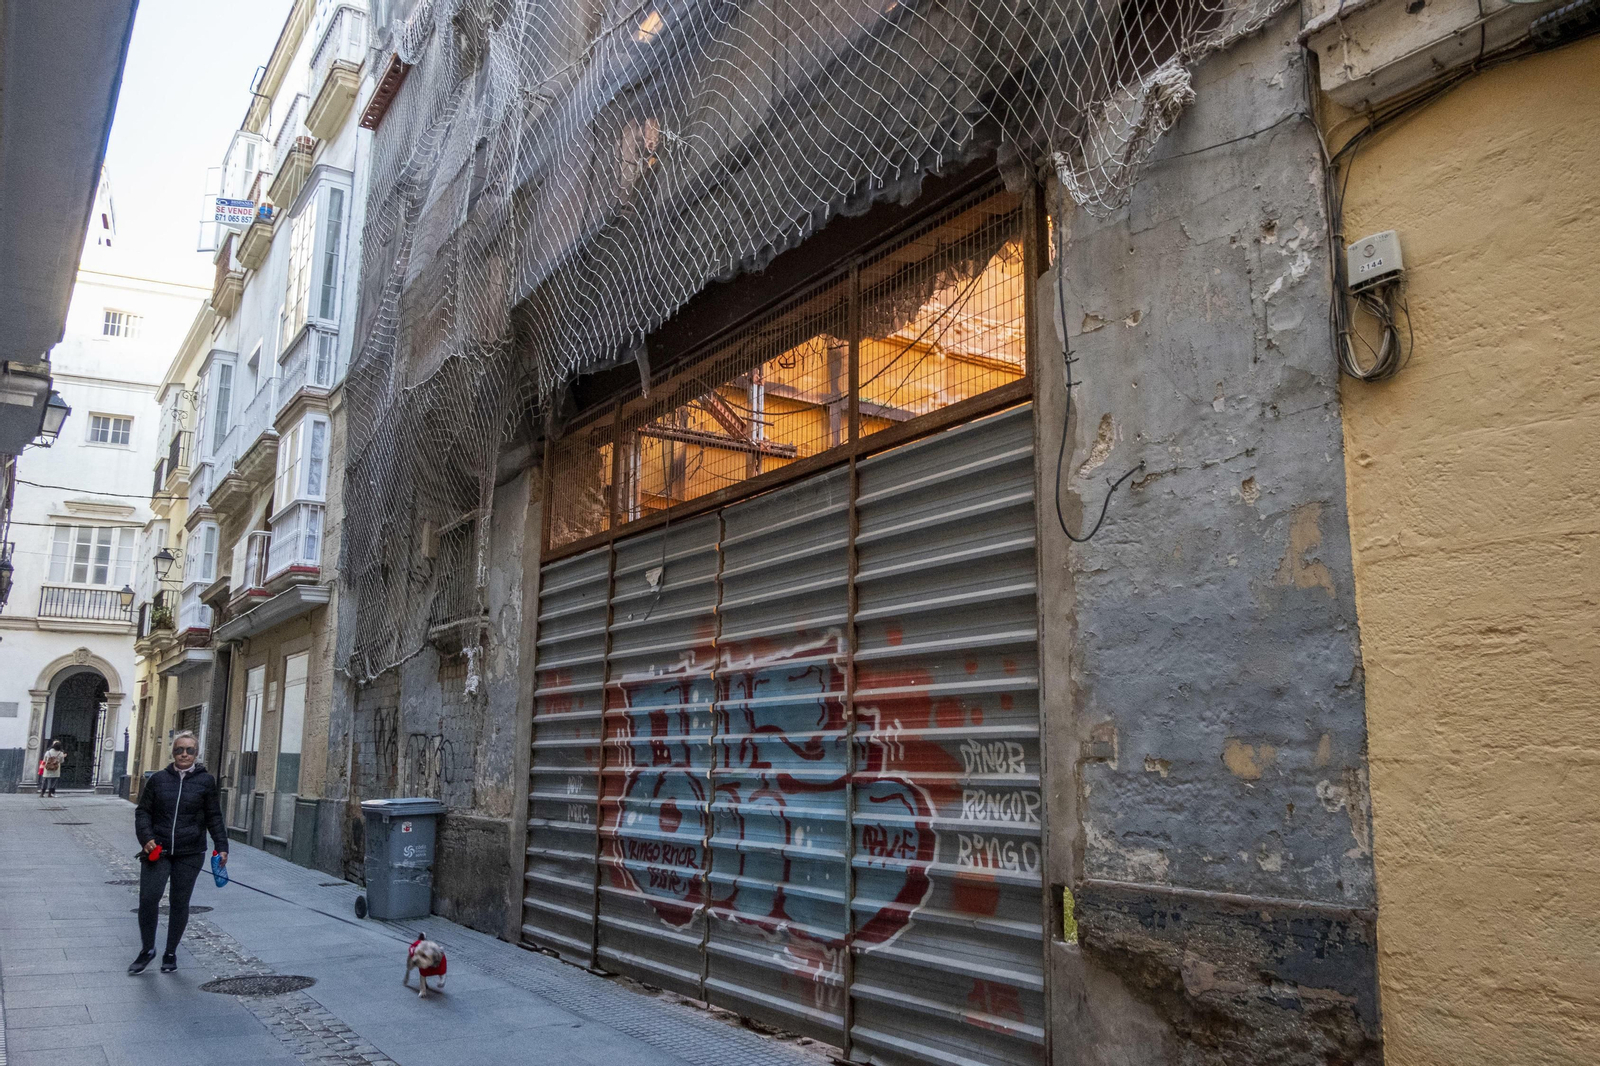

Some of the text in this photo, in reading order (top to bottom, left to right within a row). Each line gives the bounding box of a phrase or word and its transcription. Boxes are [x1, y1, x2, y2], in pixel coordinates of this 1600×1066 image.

[228, 207, 253, 215] VENDE
[228, 214, 240, 222] 065
[1360, 259, 1382, 273] 2144
